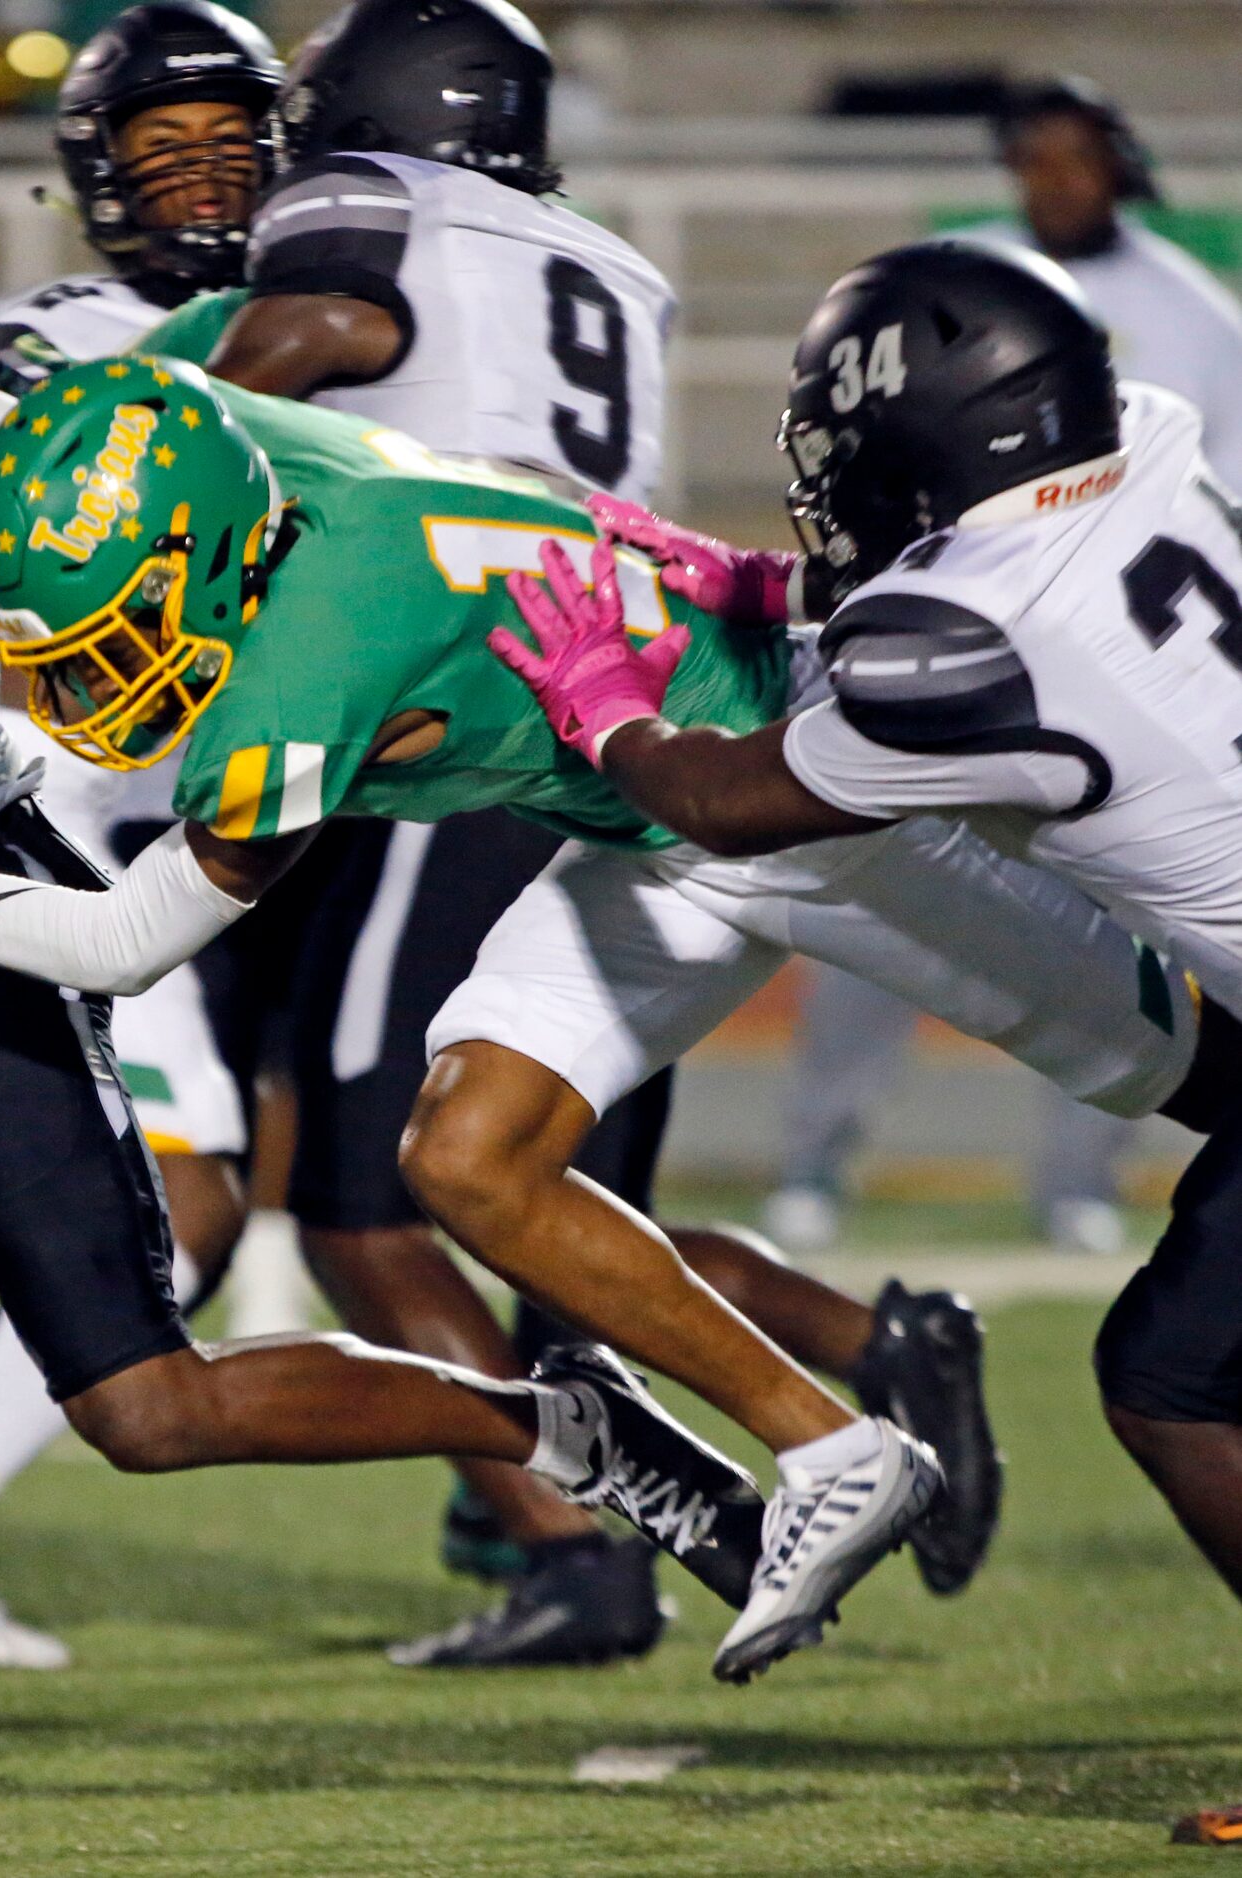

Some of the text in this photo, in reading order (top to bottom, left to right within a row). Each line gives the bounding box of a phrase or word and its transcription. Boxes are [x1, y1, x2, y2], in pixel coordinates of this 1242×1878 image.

[543, 253, 631, 491] 9
[828, 322, 908, 414] 34
[28, 404, 158, 563] Trojans
